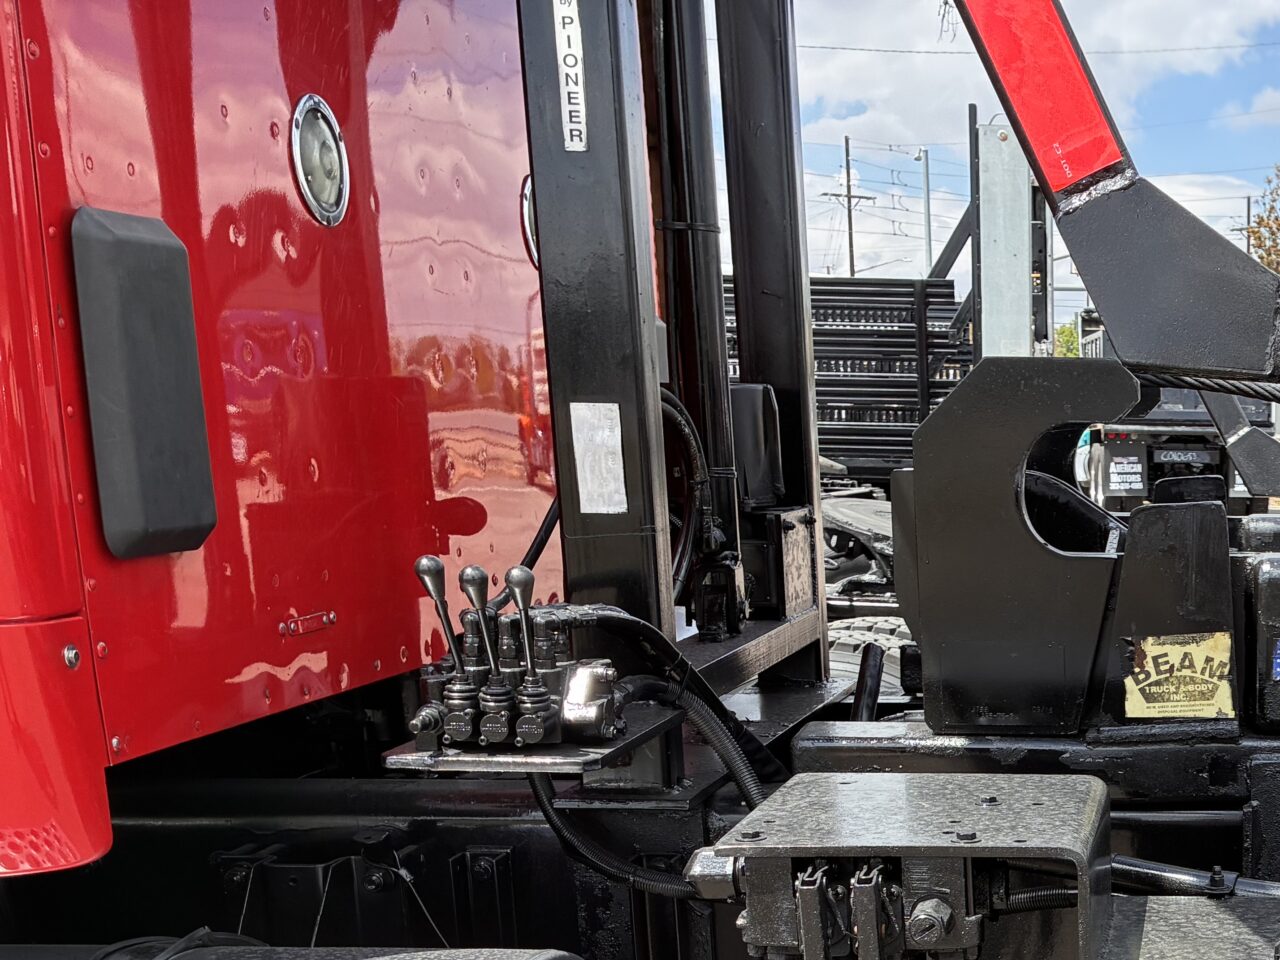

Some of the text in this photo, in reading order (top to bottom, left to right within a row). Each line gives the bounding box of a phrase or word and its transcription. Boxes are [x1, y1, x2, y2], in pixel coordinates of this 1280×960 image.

[561, 16, 583, 142] PIONEER
[1131, 651, 1229, 687] BEAM
[1144, 685, 1176, 693] TRUCK
[1188, 683, 1214, 691] BODY
